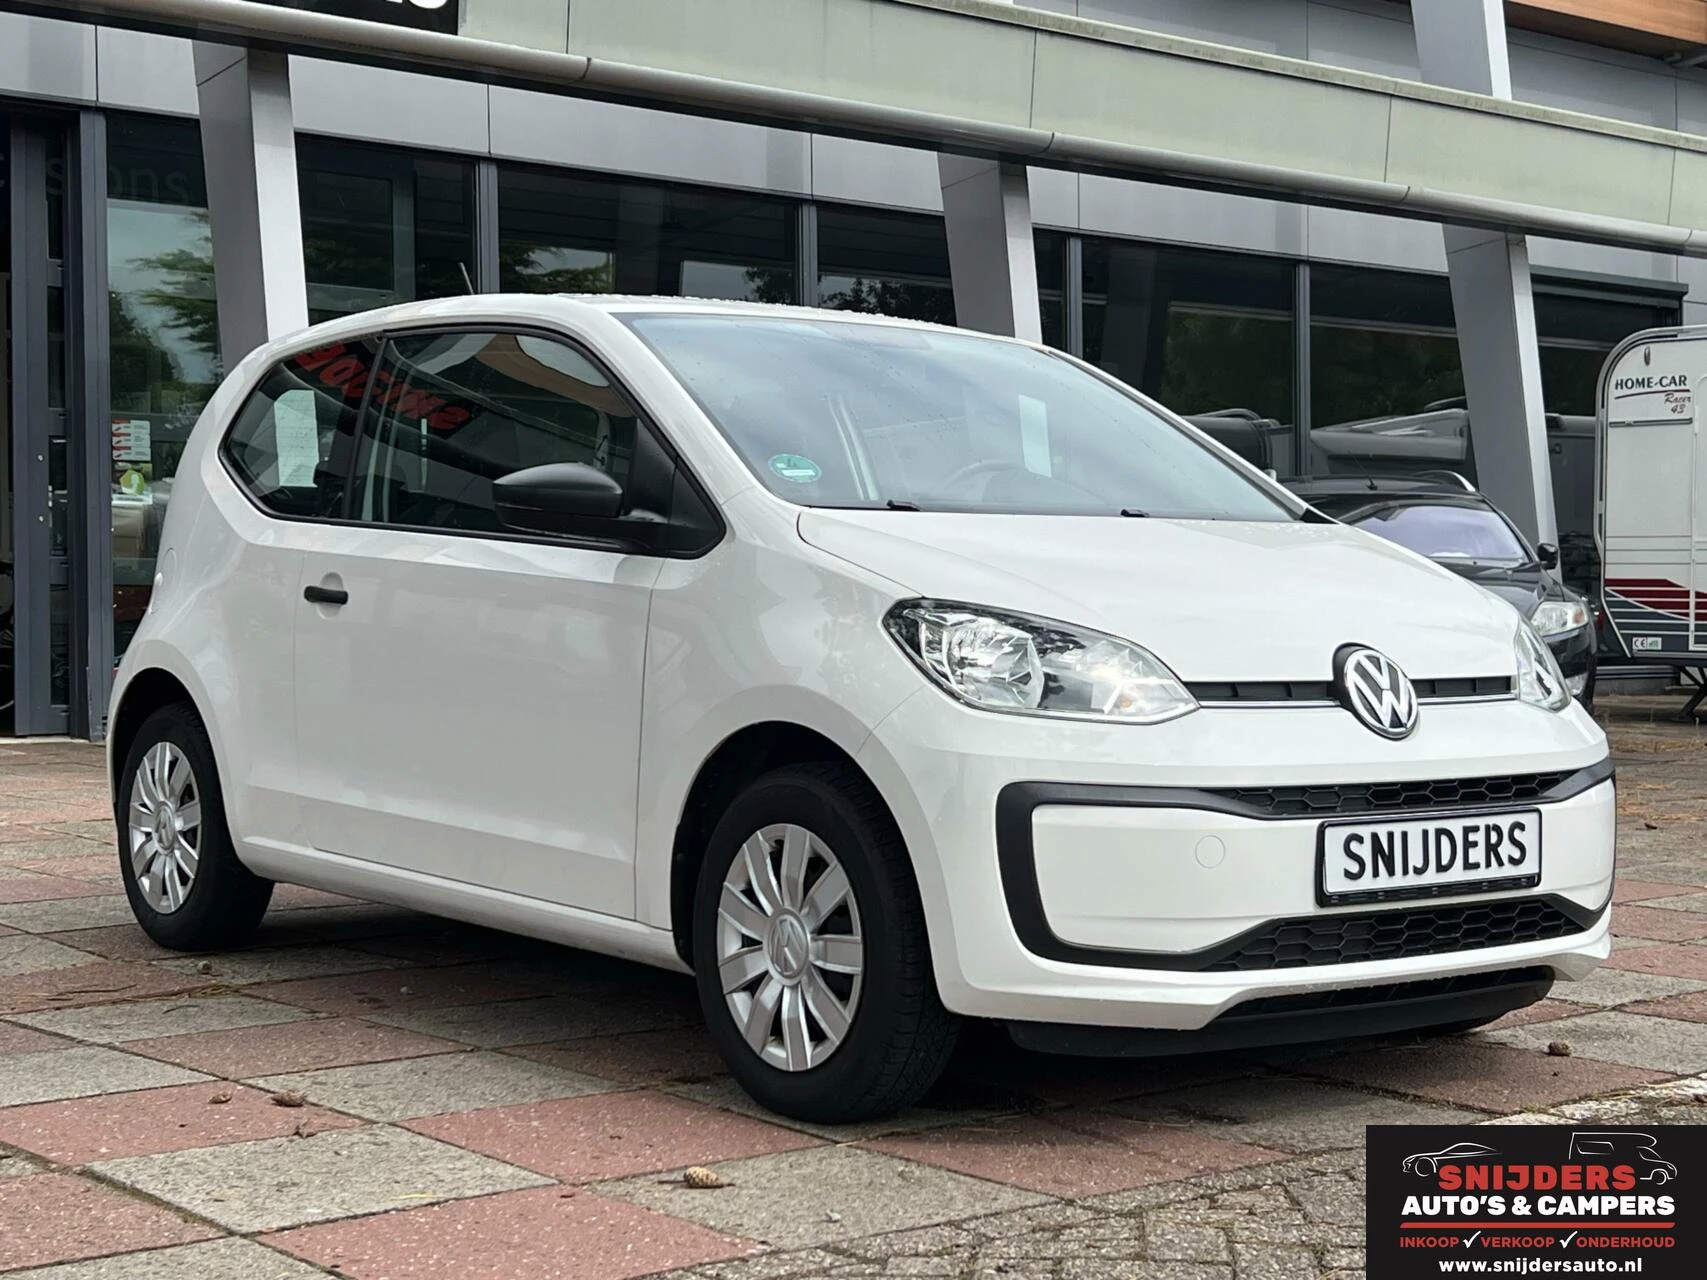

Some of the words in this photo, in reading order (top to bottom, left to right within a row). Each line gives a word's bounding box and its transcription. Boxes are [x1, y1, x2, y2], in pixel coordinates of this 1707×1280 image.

[1614, 375, 1688, 390] HOME-CAR
[1671, 403, 1686, 414] 43
[1343, 821, 1527, 880] SNIJDERS
